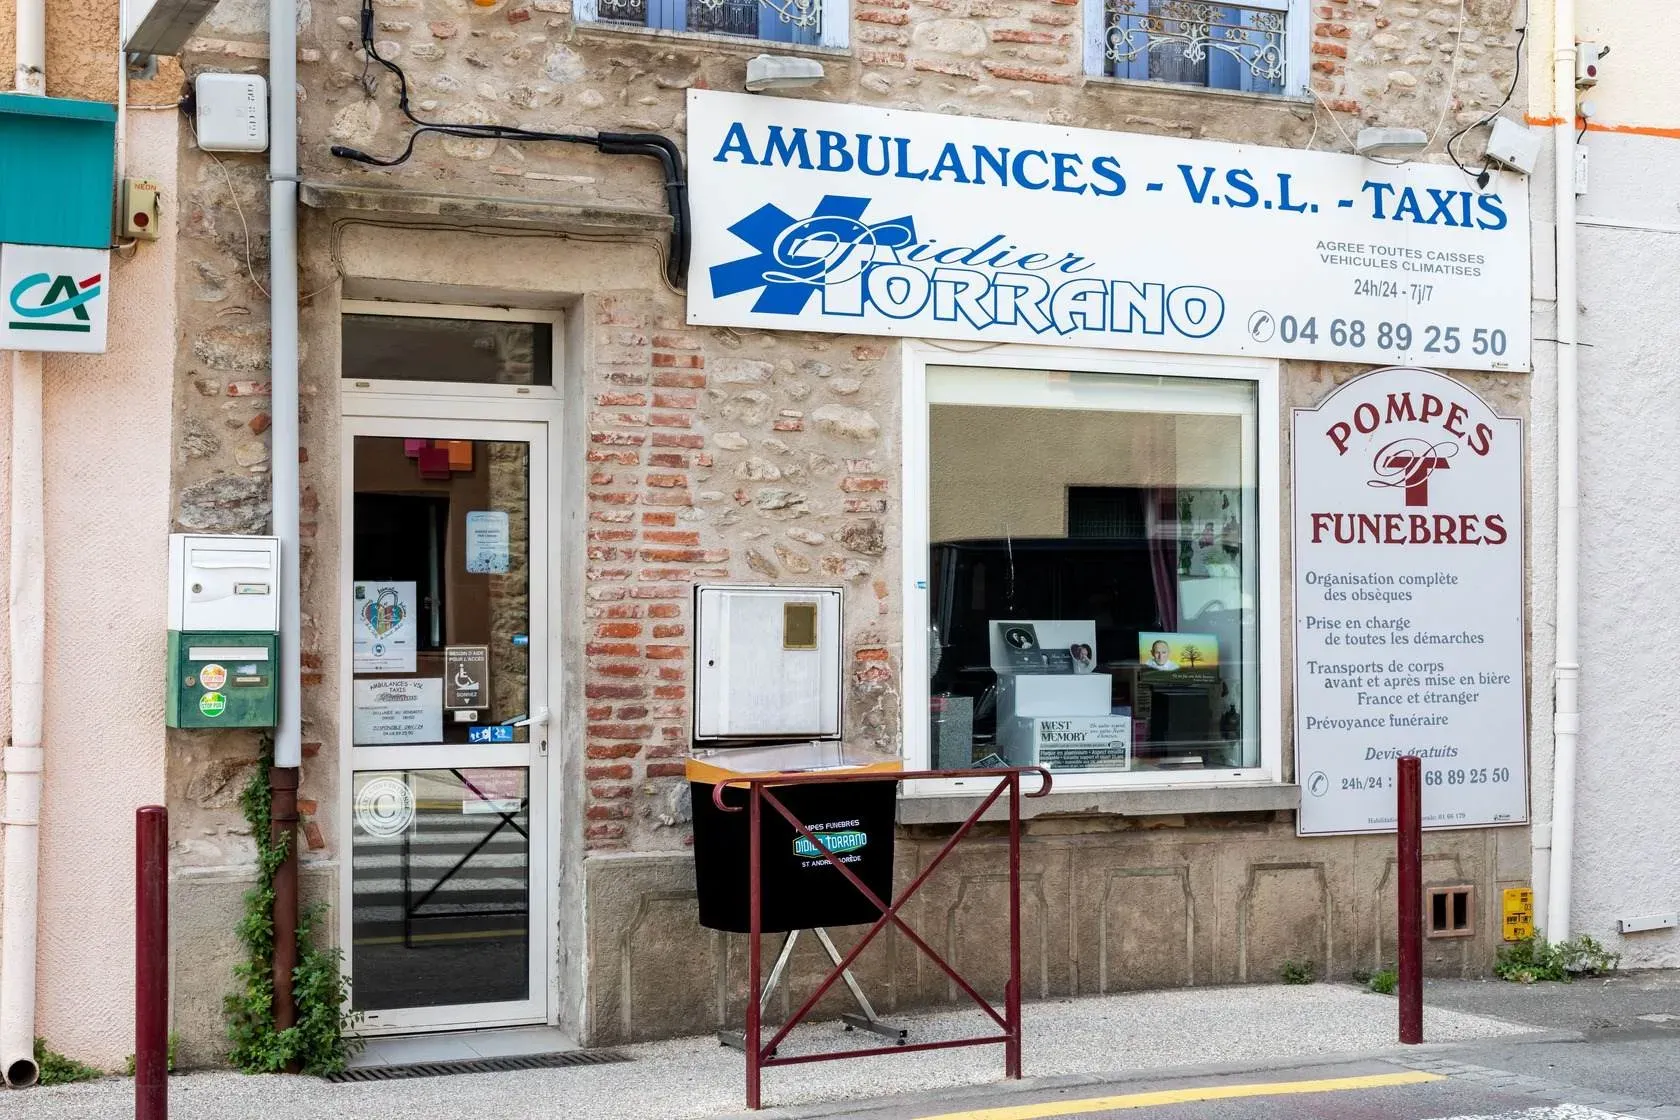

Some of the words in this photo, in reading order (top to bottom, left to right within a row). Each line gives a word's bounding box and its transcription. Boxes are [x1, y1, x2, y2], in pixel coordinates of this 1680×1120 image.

[713, 121, 1127, 198] AMBULANCES
[1177, 164, 1319, 214] V.S.L.
[1361, 180, 1509, 231] TAXIS
[134, 182, 157, 192] NEON
[1315, 240, 1366, 254] AGREE
[1368, 244, 1423, 259] TOUTES
[1426, 250, 1485, 265] CAISSES
[1319, 253, 1398, 270] VEHICULES
[1401, 261, 1482, 278] CLIMATISES
[788, 238, 1225, 338] TORRANO
[1353, 278, 1398, 298] 24h/24
[1410, 284, 1434, 305] 7j/7
[1280, 314, 1319, 345] 04
[1330, 318, 1366, 348] 68
[1376, 321, 1413, 351] 89
[1423, 325, 1461, 354] 25
[1471, 328, 1507, 356] 50
[1325, 392, 1493, 457] POMPES
[1310, 512, 1508, 546] FUNEBRES
[1305, 571, 1394, 587] Organisation
[1398, 571, 1459, 588] complète
[1324, 589, 1347, 601] des
[1351, 588, 1413, 603] obsèques
[1306, 616, 1342, 630] Prise
[1345, 618, 1362, 629] en
[1365, 615, 1411, 632] charge
[1324, 632, 1341, 645] de
[1345, 633, 1387, 645] toutes
[1391, 632, 1410, 645] les
[1413, 631, 1485, 645] démarches
[1307, 660, 1384, 677] Transports
[1388, 660, 1405, 673] de
[1408, 661, 1445, 677] corps
[1324, 675, 1363, 689] avant
[1367, 675, 1380, 688] et
[1383, 673, 1421, 689] après
[1425, 673, 1456, 686] mise
[1459, 675, 1475, 685] en
[1479, 671, 1511, 685] bière
[1357, 691, 1403, 706] France
[1407, 690, 1421, 704] et
[1423, 689, 1480, 705] étranger
[1040, 721, 1072, 731] WEST
[1306, 715, 1386, 731] Prévoyance
[1389, 713, 1449, 728] funéraire
[1040, 732, 1088, 742] MEMORY
[1364, 746, 1402, 761] Devis
[1341, 776, 1383, 790] 24h/24
[1425, 770, 1443, 786] 68
[1448, 769, 1466, 785] 89
[1470, 768, 1488, 784] 25
[1492, 767, 1510, 782] 50
[825, 819, 860, 829] FUNEBRES
[825, 832, 867, 850] TORRANO
